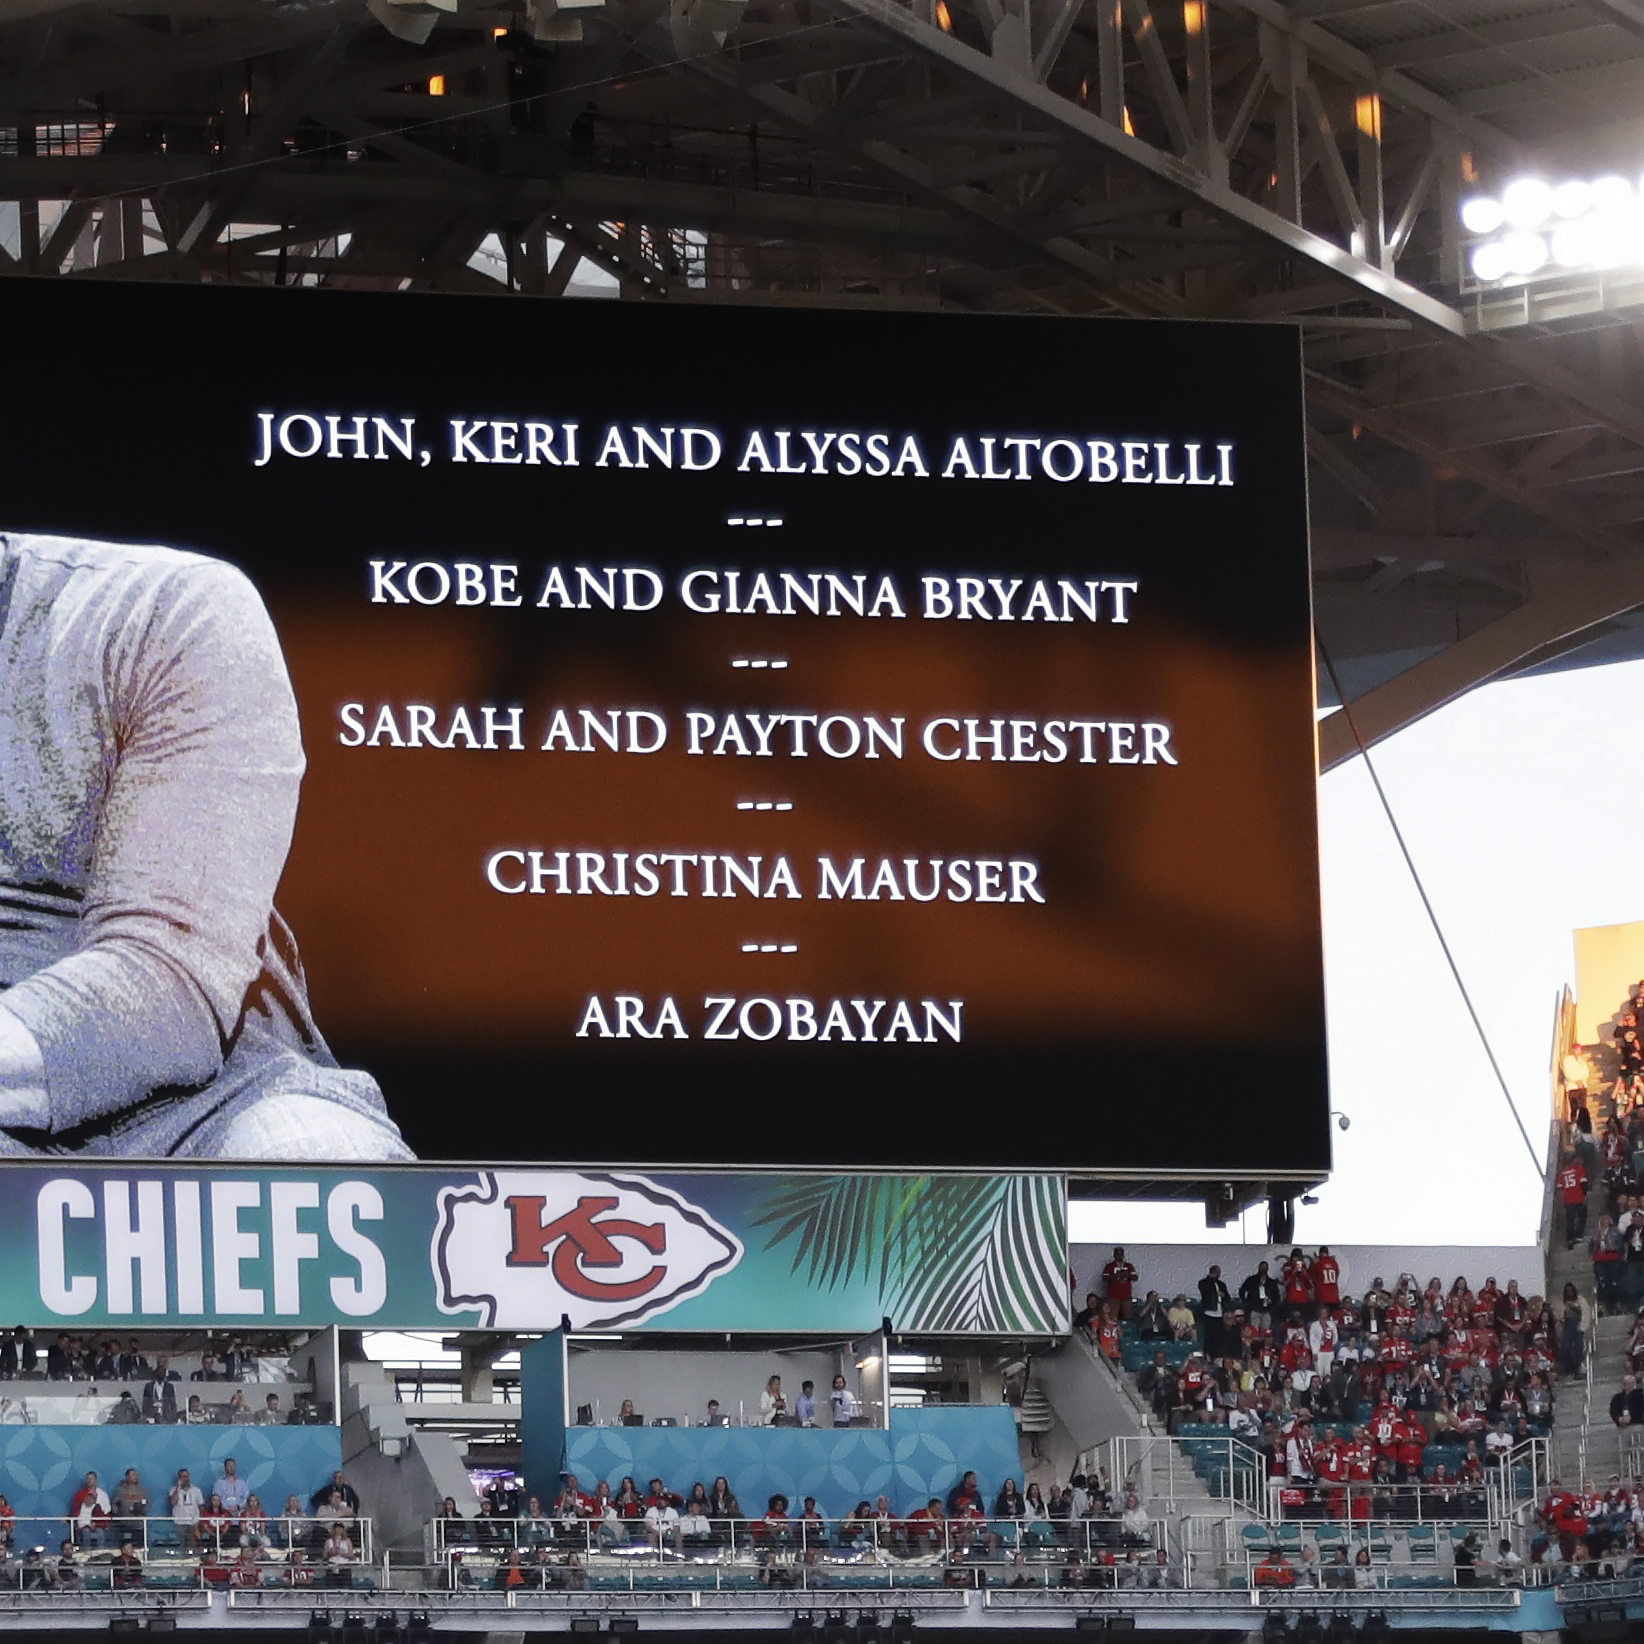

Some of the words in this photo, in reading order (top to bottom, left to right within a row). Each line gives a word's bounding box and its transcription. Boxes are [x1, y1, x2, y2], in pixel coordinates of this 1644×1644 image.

[253, 412, 432, 468] JOHN,
[448, 419, 581, 468] KERI
[594, 424, 723, 472] AND
[736, 429, 931, 478] ALYSSA
[940, 435, 1235, 487] ALTOBELLI
[368, 559, 524, 608] KOBE
[535, 565, 665, 612] AND
[680, 569, 907, 619] GIANNA
[920, 575, 1139, 625] BRYANT
[338, 702, 526, 751] SARAH
[539, 708, 668, 755] AND
[685, 711, 907, 760] PAYTON
[922, 716, 1180, 766] CHESTER
[485, 849, 804, 900] CHRISTINA
[816, 856, 1047, 904] MAUSER
[574, 994, 691, 1040] ARA
[702, 995, 965, 1044] ZOBAYAN
[37, 1178, 387, 1316] CHIEFS
[1324, 1269, 1336, 1284] 10
